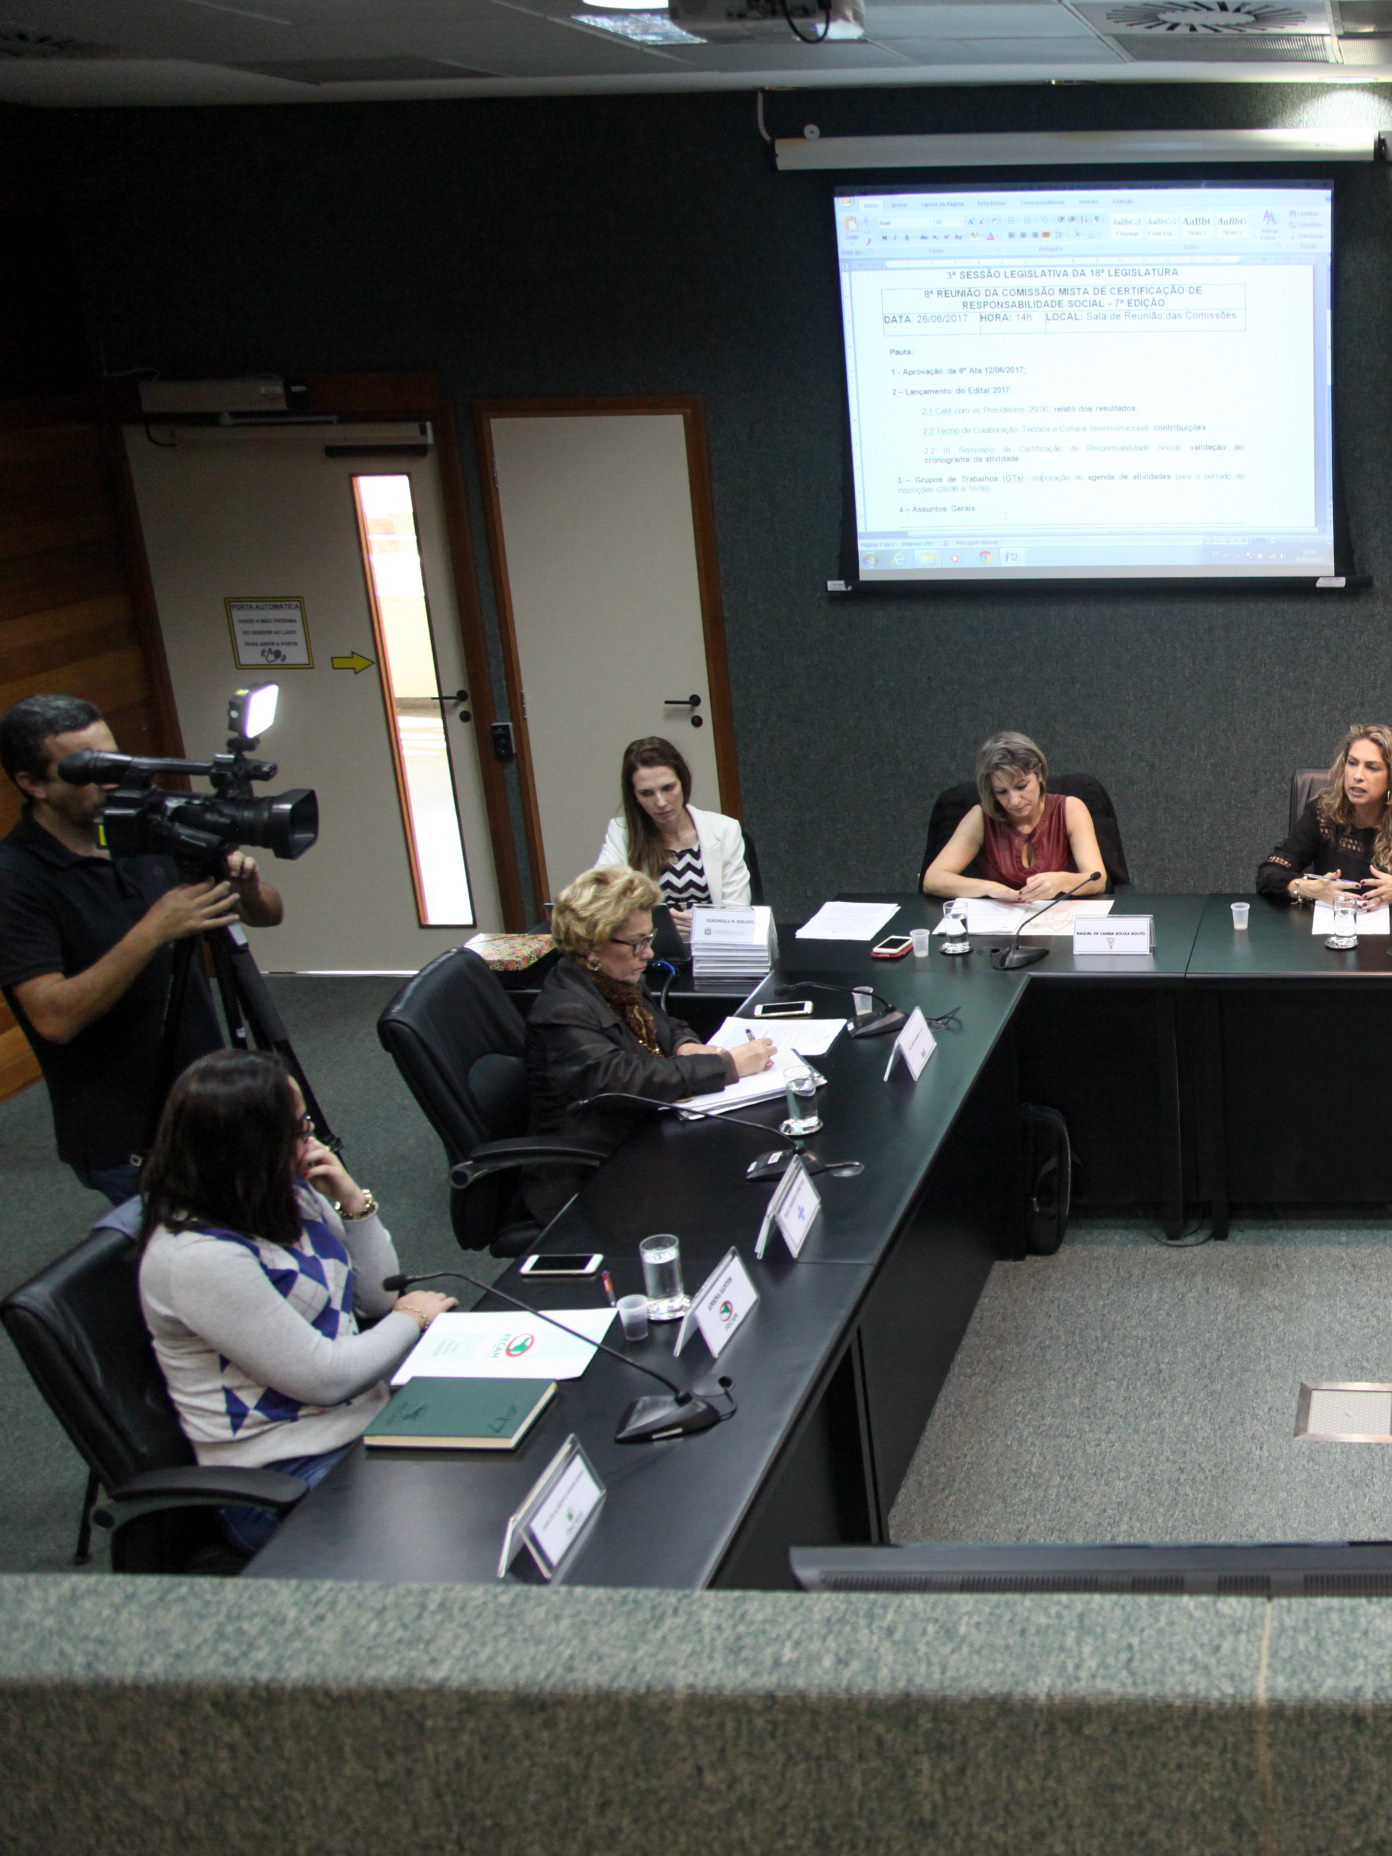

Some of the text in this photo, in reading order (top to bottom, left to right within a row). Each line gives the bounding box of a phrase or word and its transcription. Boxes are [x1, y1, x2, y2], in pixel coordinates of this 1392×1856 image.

[947, 268, 1179, 280] 3ª SESSÃO LEGISLATIVA DA 18ª LEGISLATURA
[924, 285, 1203, 298] 8ª REUNIÃO DA COMISSÃO MISTA DE CERTIFICAÇÃO DE
[962, 297, 1165, 310] RESPONSABILIDADE SOCIAL 7ª EDIÇÃO
[884, 314, 968, 324] DATA: 26/06/2017
[980, 313, 1032, 323] HORA: 14h
[1046, 310, 1237, 321] LOCAL: Sala de Reunião das Comissões
[902, 368, 944, 376] Aprovação
[969, 367, 982, 375] Ata
[905, 388, 952, 396] Lançamento
[955, 387, 966, 395] do
[968, 387, 990, 395] Edital
[935, 407, 952, 415] Café
[983, 406, 1026, 414] Presidentes
[1053, 405, 1076, 413] relato
[1078, 405, 1093, 413] dos
[936, 427, 960, 435] Termo
[973, 426, 1018, 435] Colaboração
[1022, 425, 1050, 433] Técnica
[1059, 425, 1087, 433] Cultural
[959, 446, 995, 454] Seminário
[1019, 445, 1062, 454] Certificação
[1087, 444, 1150, 453] Responsabilidade
[1190, 444, 1226, 452] validação
[924, 456, 970, 465] cronograma
[915, 476, 943, 485] Grupos
[961, 475, 998, 483] Trabalhos
[1031, 474, 1070, 483] elaboração
[1087, 474, 1115, 482] agenda
[1175, 474, 1192, 482] para
[1204, 473, 1232, 481] período
[897, 487, 934, 495] inscrições
[230, 603, 254, 611] PORTA
